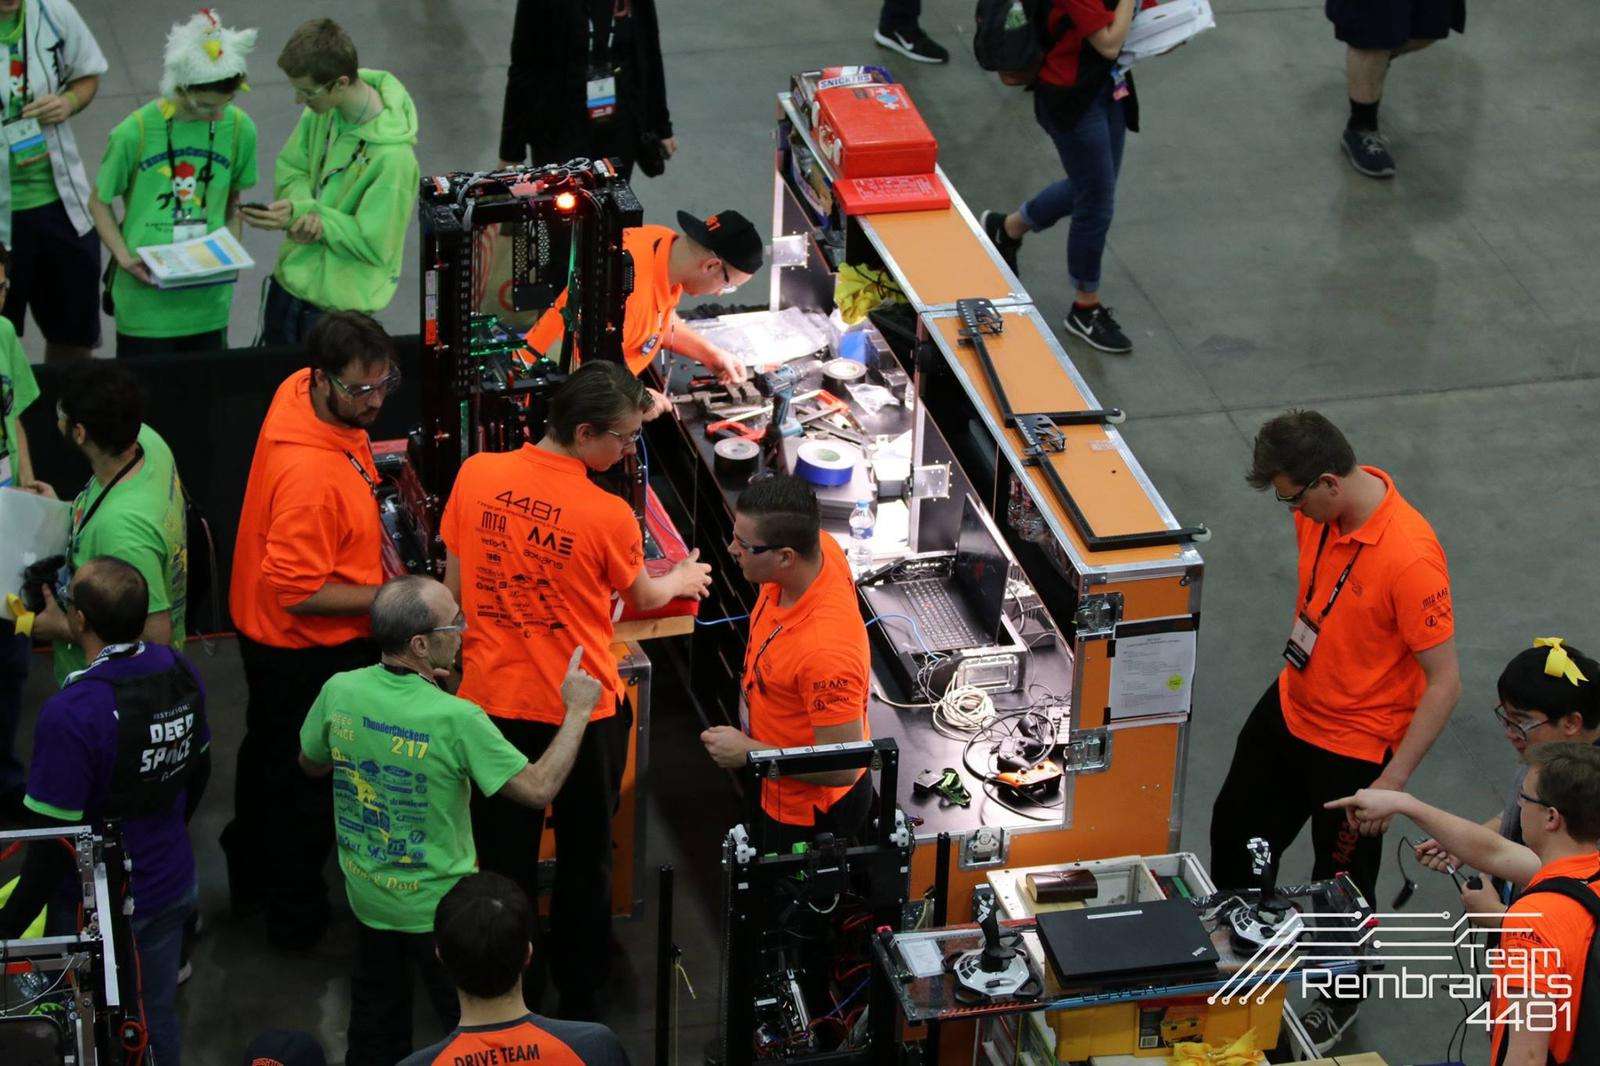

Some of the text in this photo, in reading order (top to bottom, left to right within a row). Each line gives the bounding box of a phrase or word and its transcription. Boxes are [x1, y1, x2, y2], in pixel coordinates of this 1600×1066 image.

[495, 490, 561, 525] 4481
[149, 713, 194, 744] DEEP
[139, 733, 194, 773] SPACE
[391, 735, 429, 759] 217
[454, 1043, 541, 1066] DRIVE TEAM
